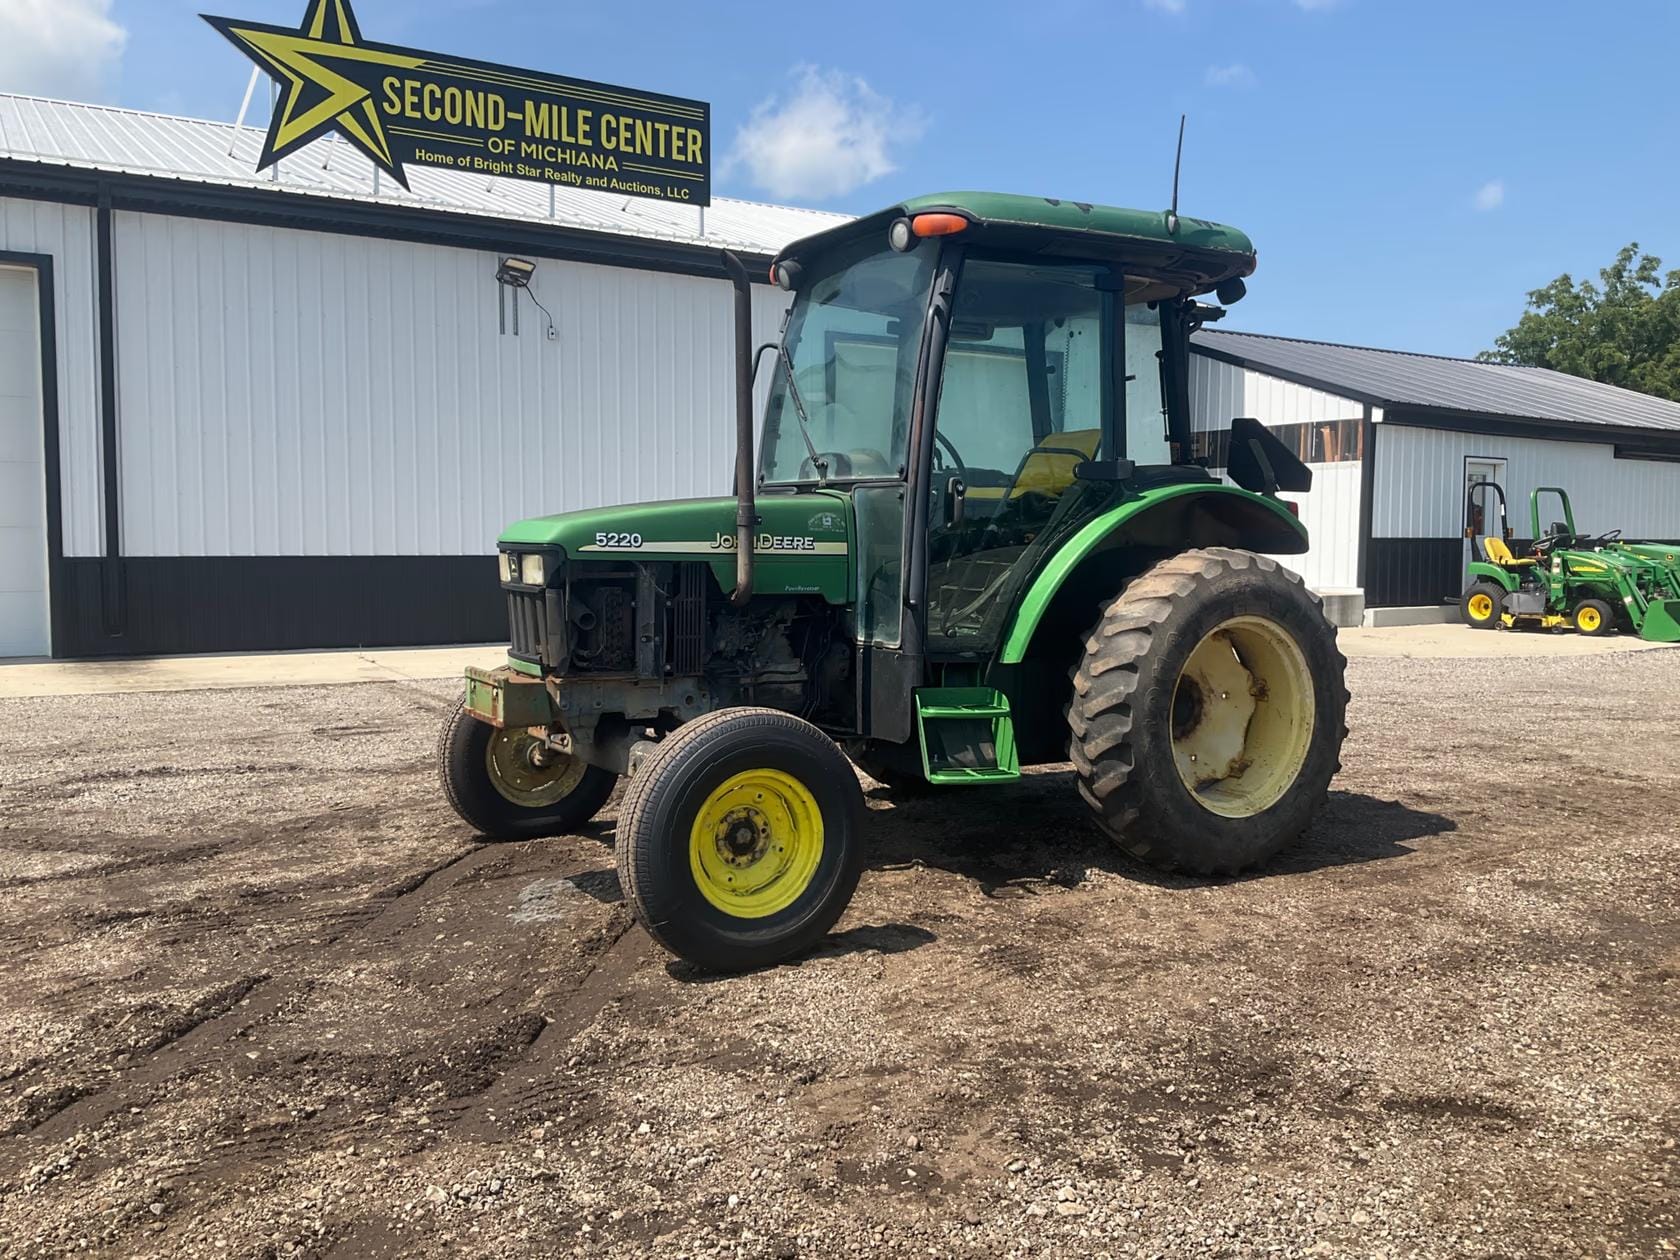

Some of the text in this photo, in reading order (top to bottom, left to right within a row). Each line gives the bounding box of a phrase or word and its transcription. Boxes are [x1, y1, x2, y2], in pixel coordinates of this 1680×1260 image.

[382, 76, 703, 165] SECOND-MILE CENTER
[488, 137, 619, 172] OF MICHIANA
[415, 148, 690, 200] Home of Bright Star Realty and Auctions, LLC
[595, 532, 643, 548] 5220
[759, 532, 815, 550] DEERE
